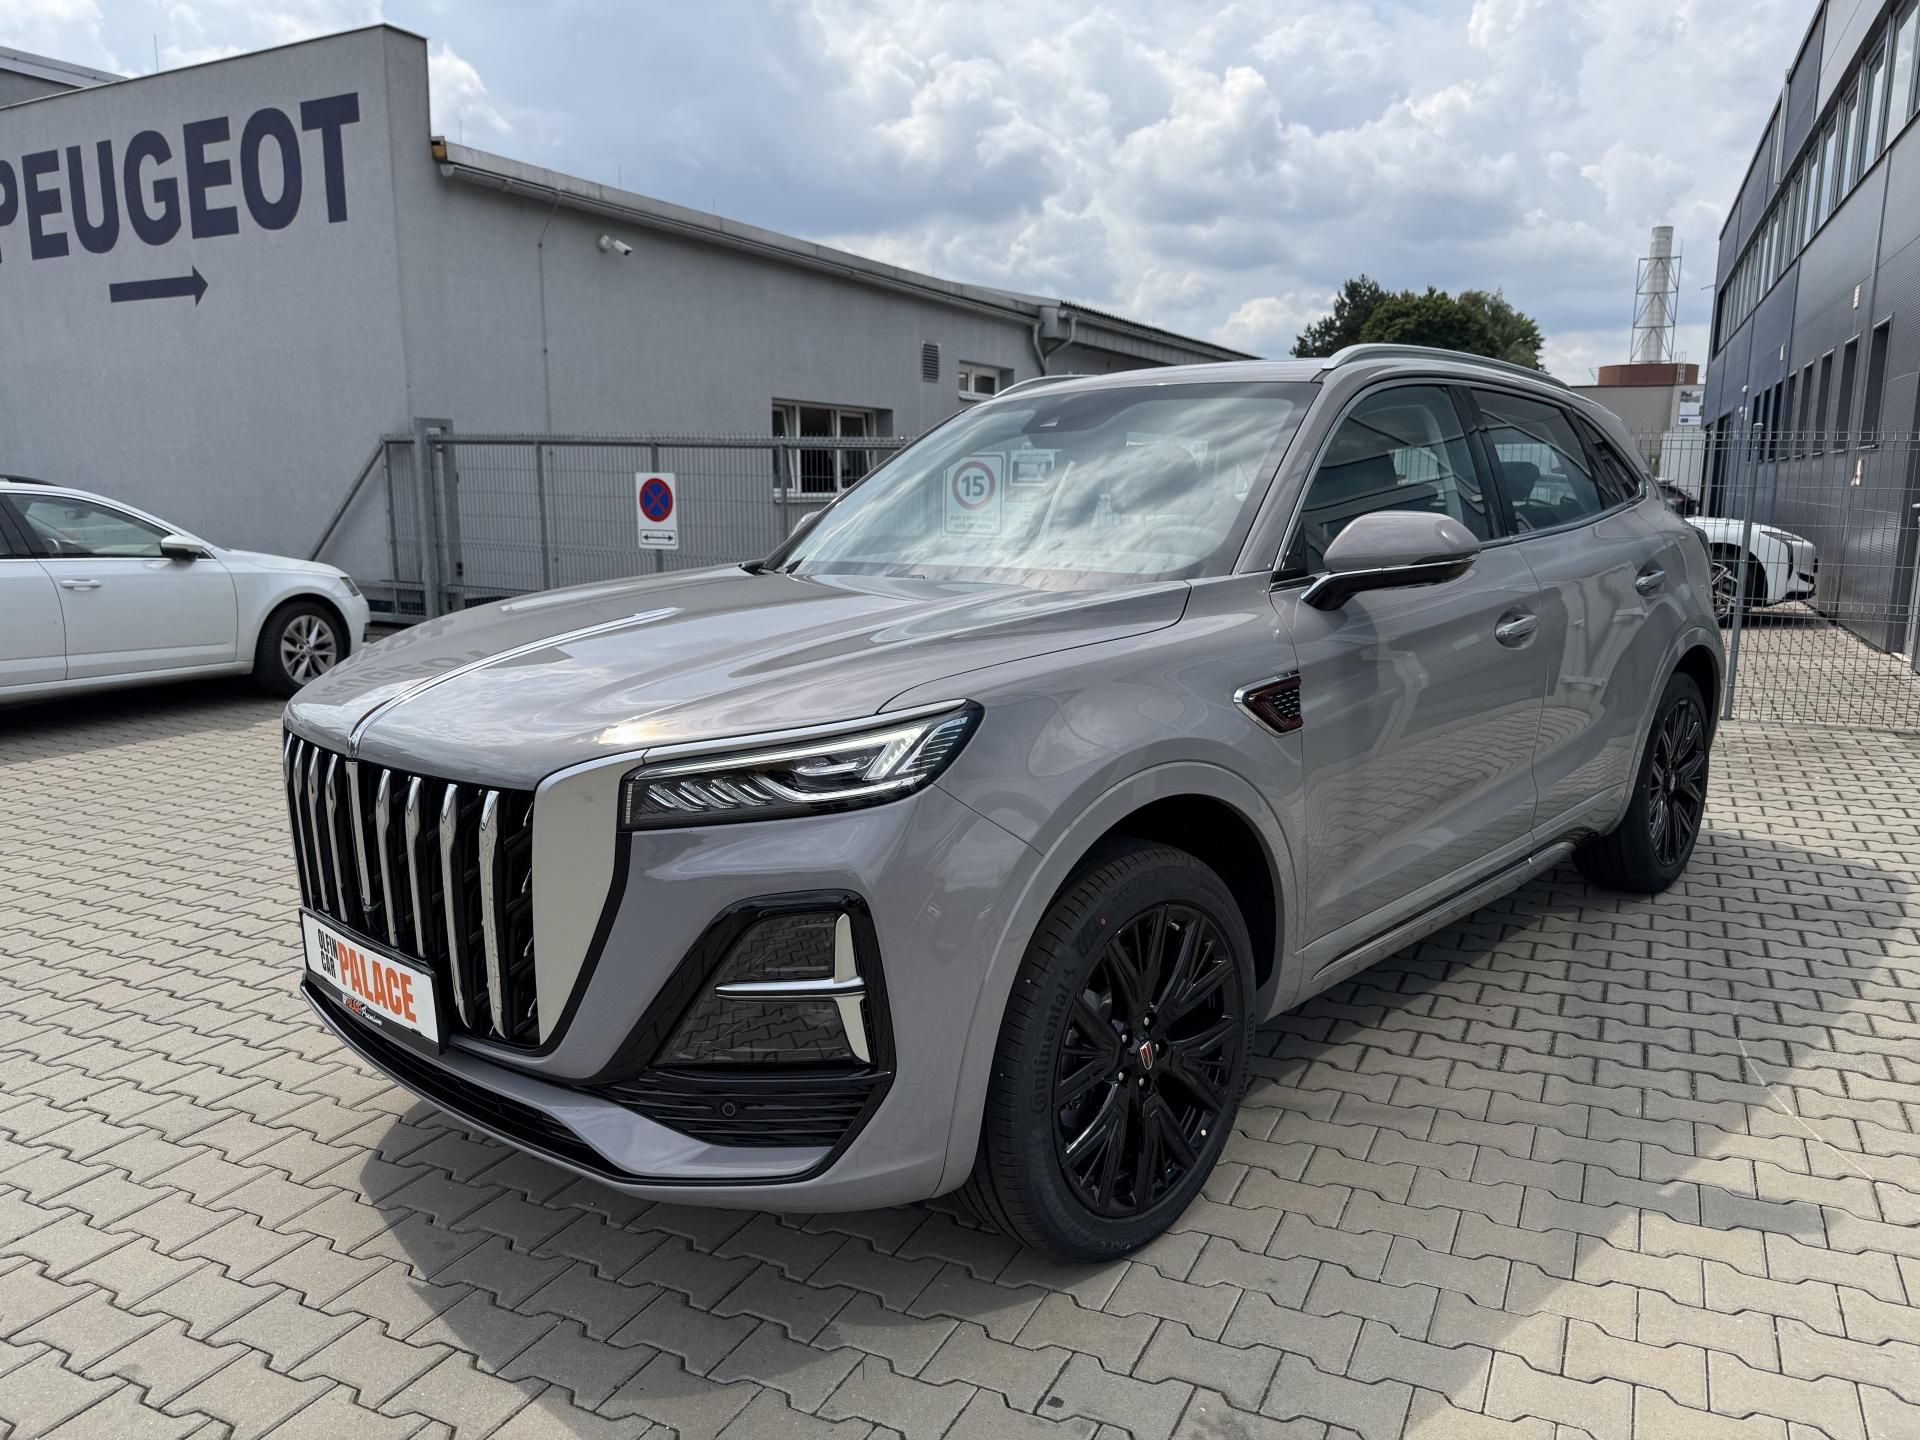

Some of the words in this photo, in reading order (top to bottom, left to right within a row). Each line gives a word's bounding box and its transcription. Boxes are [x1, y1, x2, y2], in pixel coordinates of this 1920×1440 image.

[961, 475, 985, 497] 15
[317, 928, 339, 961] OLFIN
[320, 950, 337, 979] CAR
[337, 941, 417, 1023] PALACE
[1030, 983, 1071, 1115] Continental
